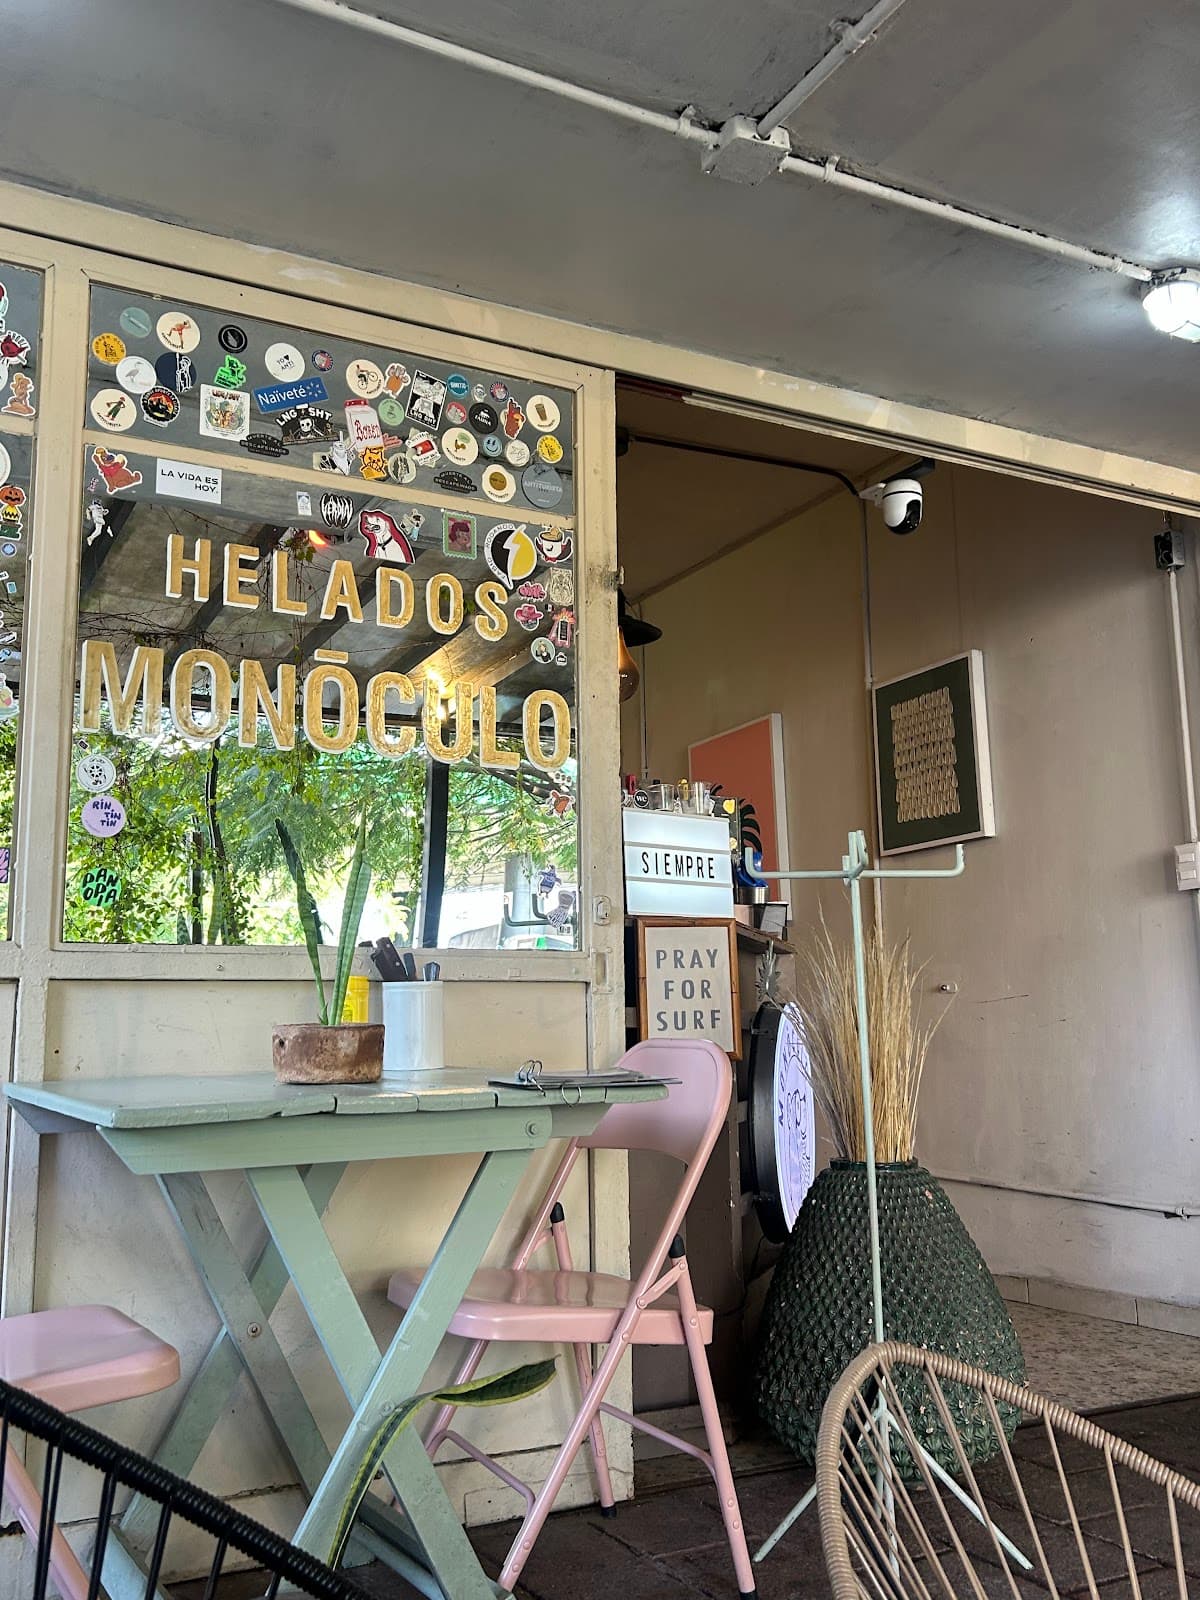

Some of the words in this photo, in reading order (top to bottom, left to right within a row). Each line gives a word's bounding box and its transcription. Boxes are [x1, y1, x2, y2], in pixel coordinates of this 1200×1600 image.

[256, 384, 308, 406] Naïveté
[276, 410, 297, 427] LNG
[308, 408, 333, 422] SHT
[160, 468, 175, 478] LA
[177, 470, 203, 483] VIDA
[204, 476, 219, 485] ES
[165, 533, 509, 642] HELADOS
[641, 850, 716, 880] SIEMPRE
[655, 948, 719, 970] PRAY
[663, 979, 712, 1000] FOR
[656, 1009, 722, 1032] SURF
